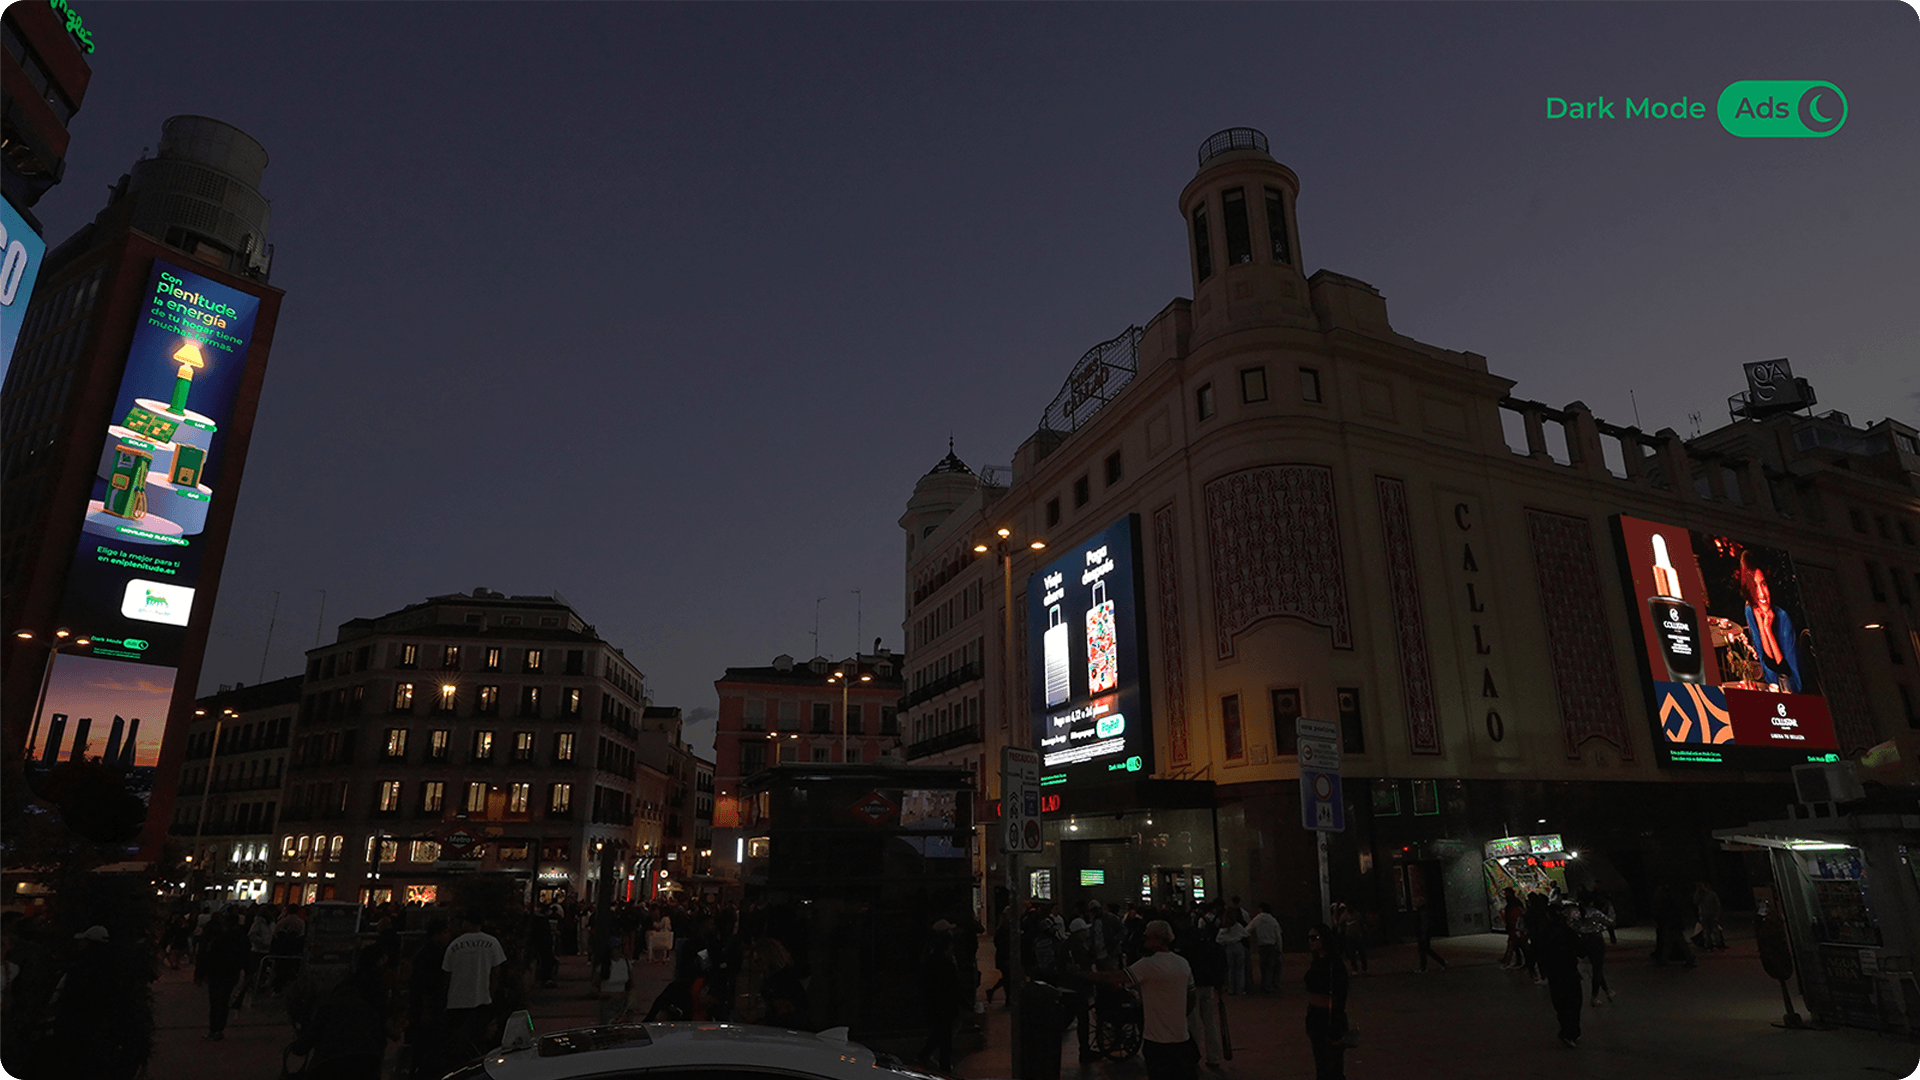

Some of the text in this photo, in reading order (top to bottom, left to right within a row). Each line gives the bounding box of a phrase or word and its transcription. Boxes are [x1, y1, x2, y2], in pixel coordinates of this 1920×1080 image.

[160, 272, 183, 286] Con
[153, 296, 226, 329] la energía
[148, 318, 192, 338] muchas
[150, 308, 243, 346] de tu hogar tiene
[96, 546, 118, 556] Elige
[128, 553, 153, 562] mejor
[154, 558, 172, 566] para
[1454, 503, 1504, 742] CALLAO
[448, 835, 471, 843] Metro
